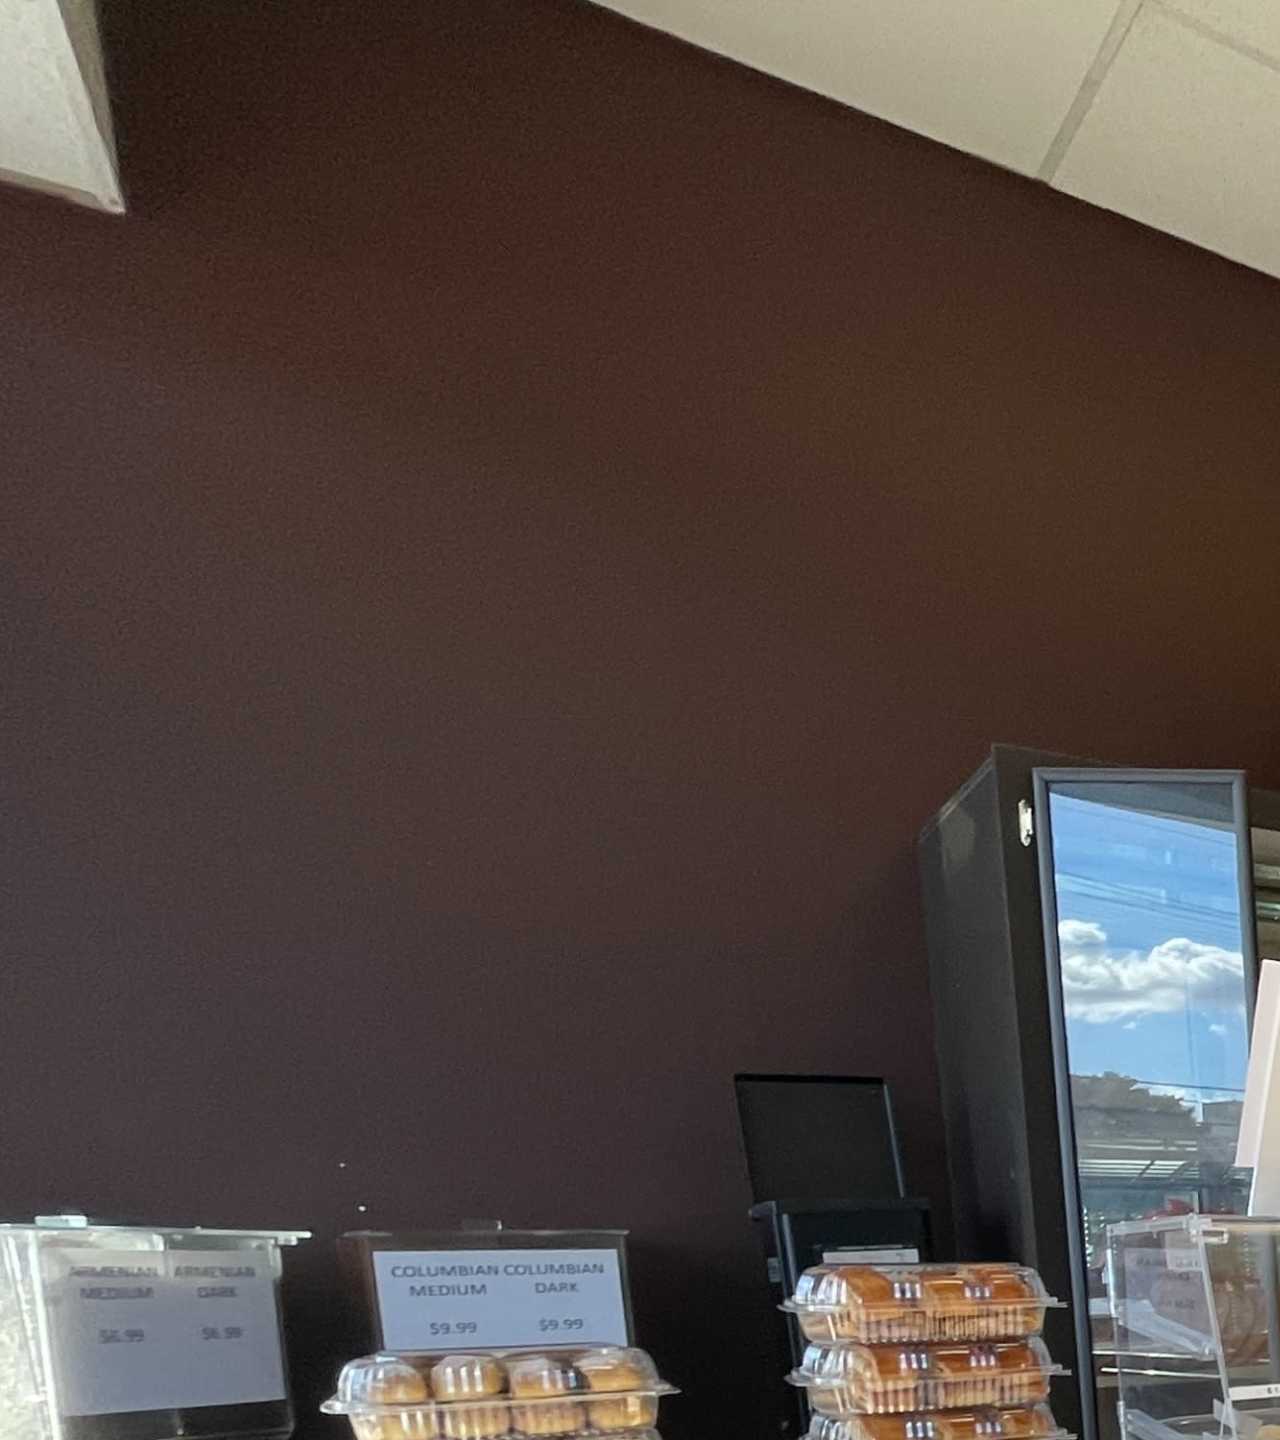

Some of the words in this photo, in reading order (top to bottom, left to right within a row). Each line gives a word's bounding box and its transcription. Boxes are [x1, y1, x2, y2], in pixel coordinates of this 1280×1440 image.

[391, 1264, 499, 1278] COLUMBIAN
[503, 1263, 605, 1276] COLUMBIAN
[409, 1283, 488, 1297] MEDIUM
[535, 1281, 580, 1294] DARK
[429, 1321, 478, 1336] $9.99
[539, 1318, 585, 1332] $9.99
